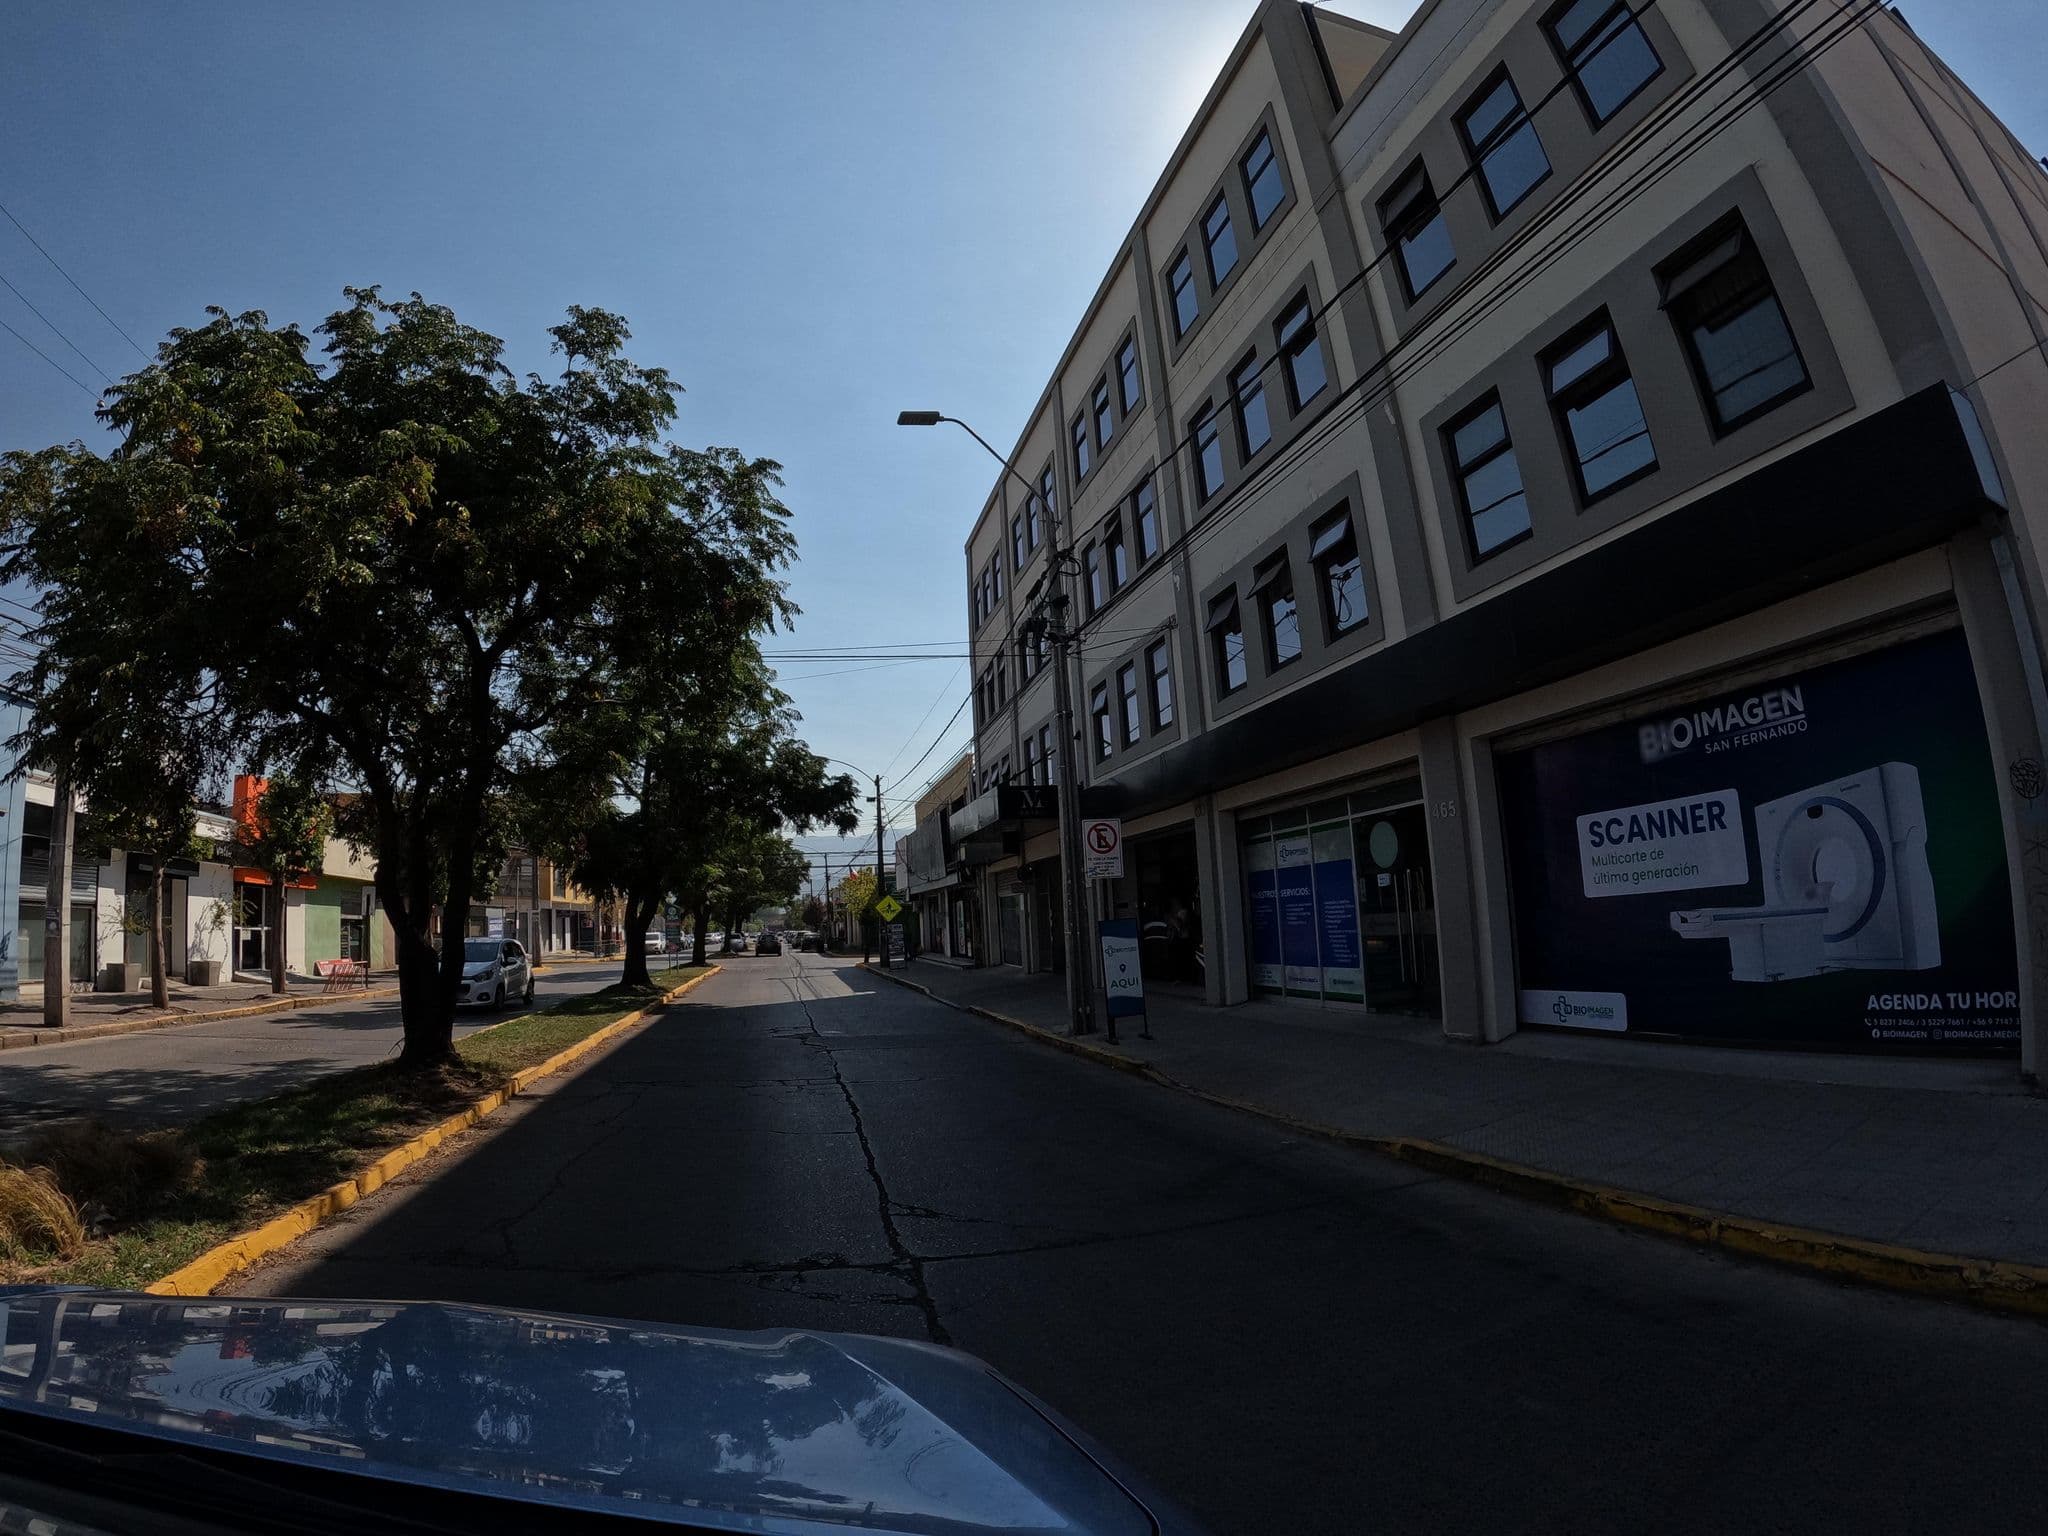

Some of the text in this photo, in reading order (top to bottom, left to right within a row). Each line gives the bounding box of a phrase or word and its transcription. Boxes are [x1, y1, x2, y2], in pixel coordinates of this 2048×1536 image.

[1638, 685, 1805, 765] BIOIMAGEN
[1704, 719, 1808, 754] SAN FERNANDO
[1432, 800, 1456, 819] 465
[1588, 800, 1727, 847] SCANNER
[1592, 848, 1664, 867] Multicorte de
[1593, 862, 1699, 885] última generación
[1111, 977, 1139, 989] AQUI
[1866, 992, 1943, 1010] AGENDA
[1946, 991, 1971, 1009] TU
